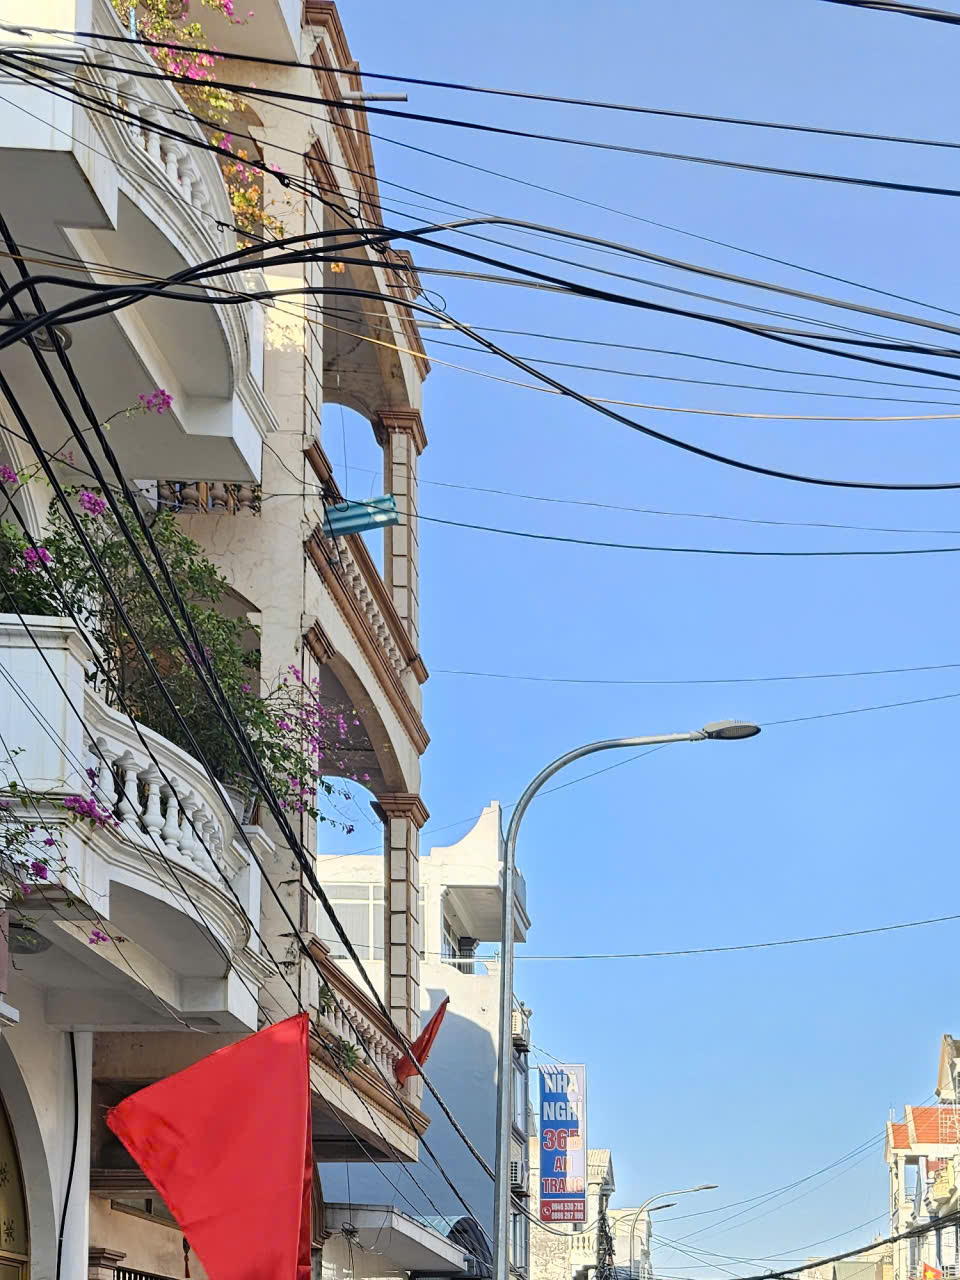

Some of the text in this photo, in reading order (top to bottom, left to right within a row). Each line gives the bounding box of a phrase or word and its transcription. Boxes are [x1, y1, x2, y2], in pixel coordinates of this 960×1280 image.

[544, 1071, 578, 1093] NHÀ
[543, 1096, 583, 1121] NGHỈ
[554, 1156, 572, 1171] AN
[542, 1176, 584, 1193] TRANG
